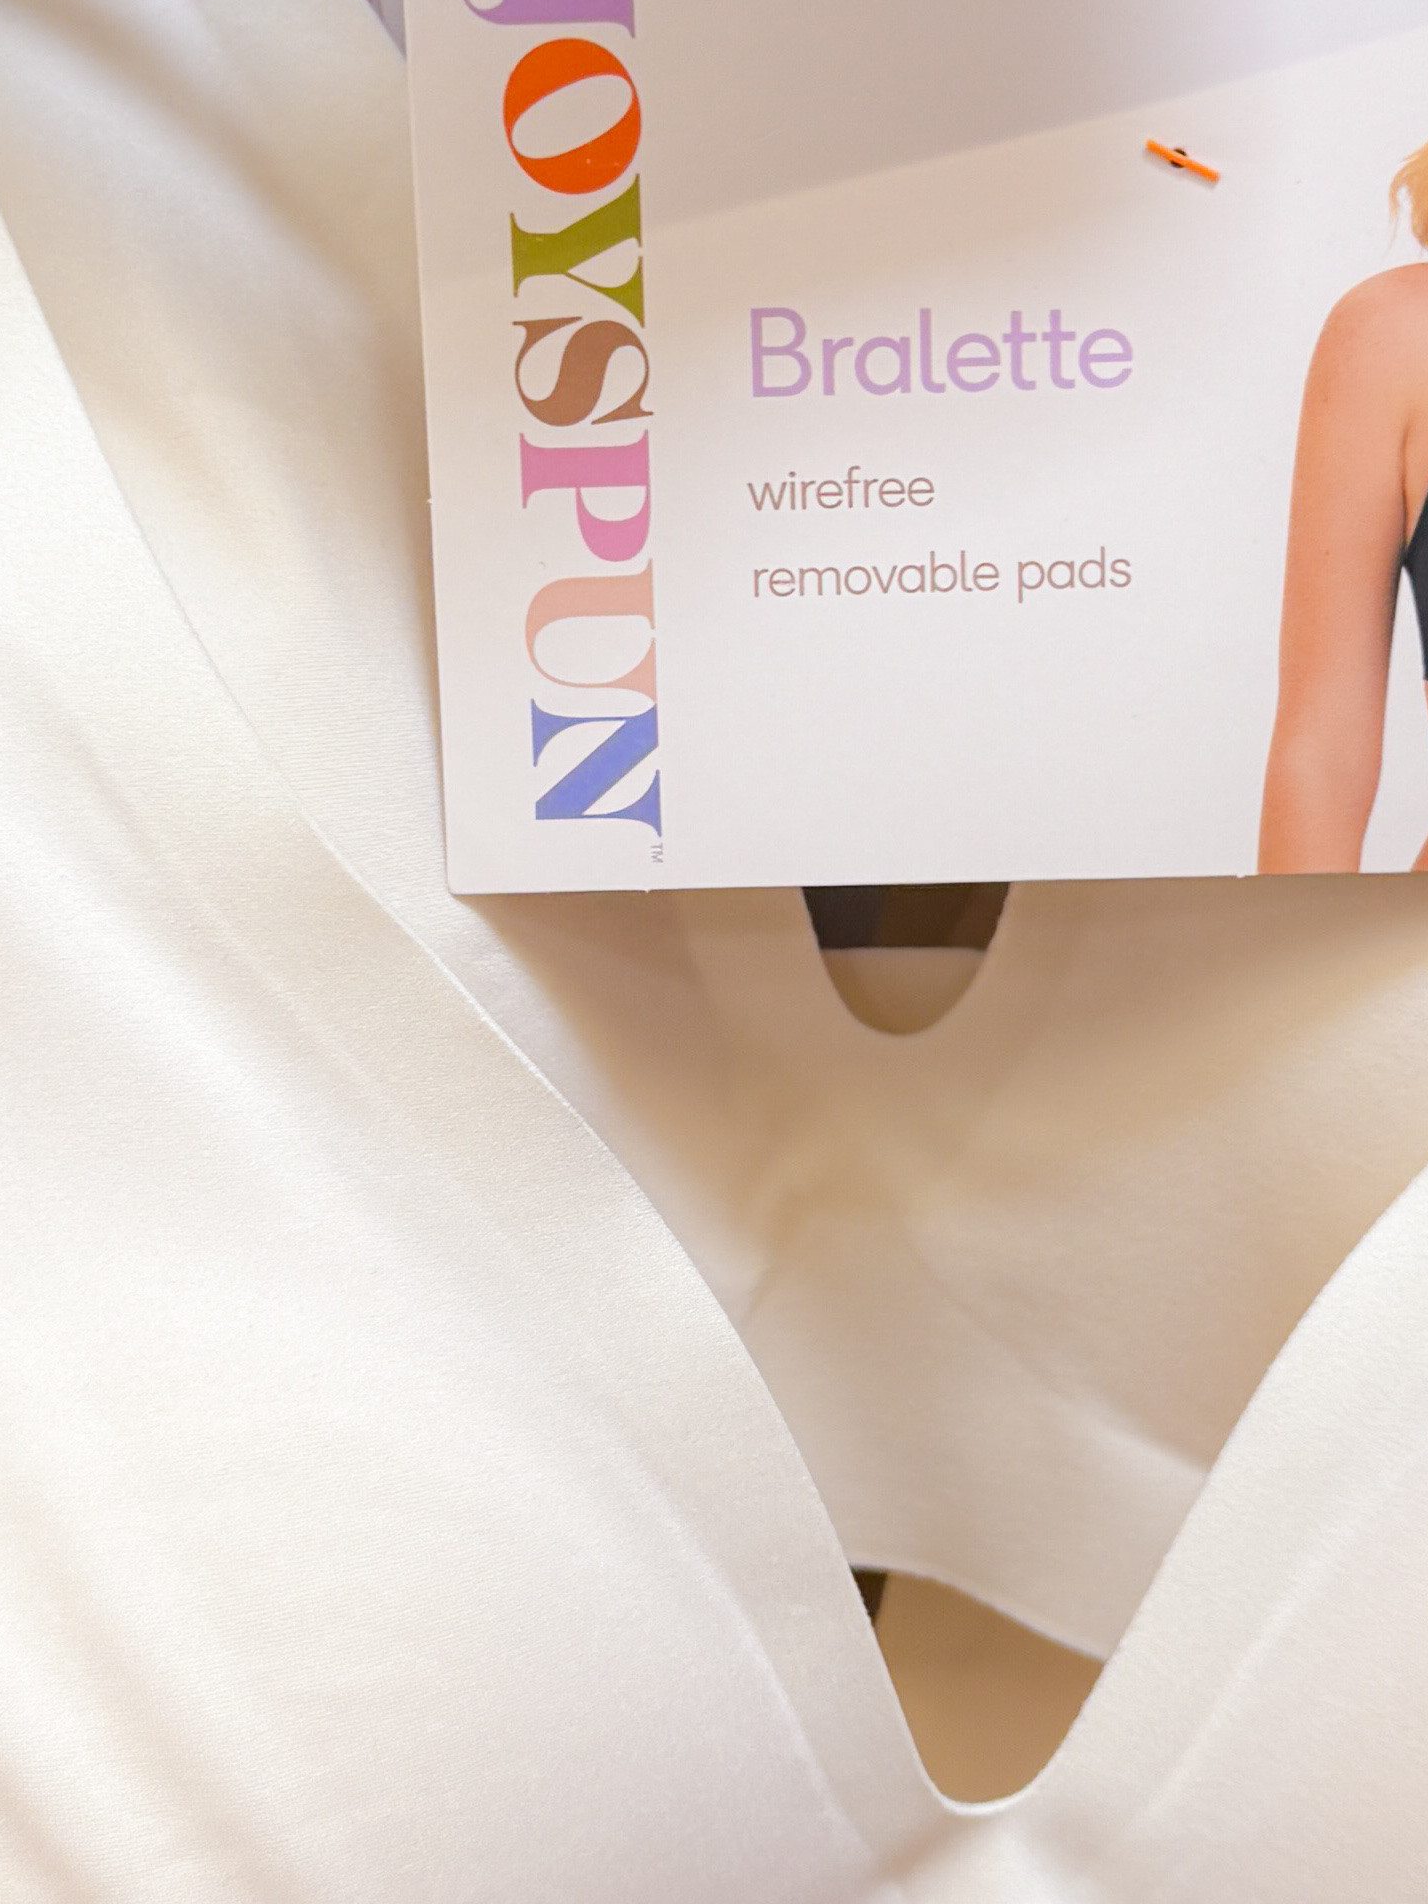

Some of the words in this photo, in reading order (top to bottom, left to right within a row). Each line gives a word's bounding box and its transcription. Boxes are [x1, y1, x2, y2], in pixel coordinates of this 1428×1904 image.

[749, 306, 1135, 399] Bralette
[747, 466, 936, 513] wirefree
[752, 550, 1002, 599] removable
[1017, 549, 1133, 604] pads
